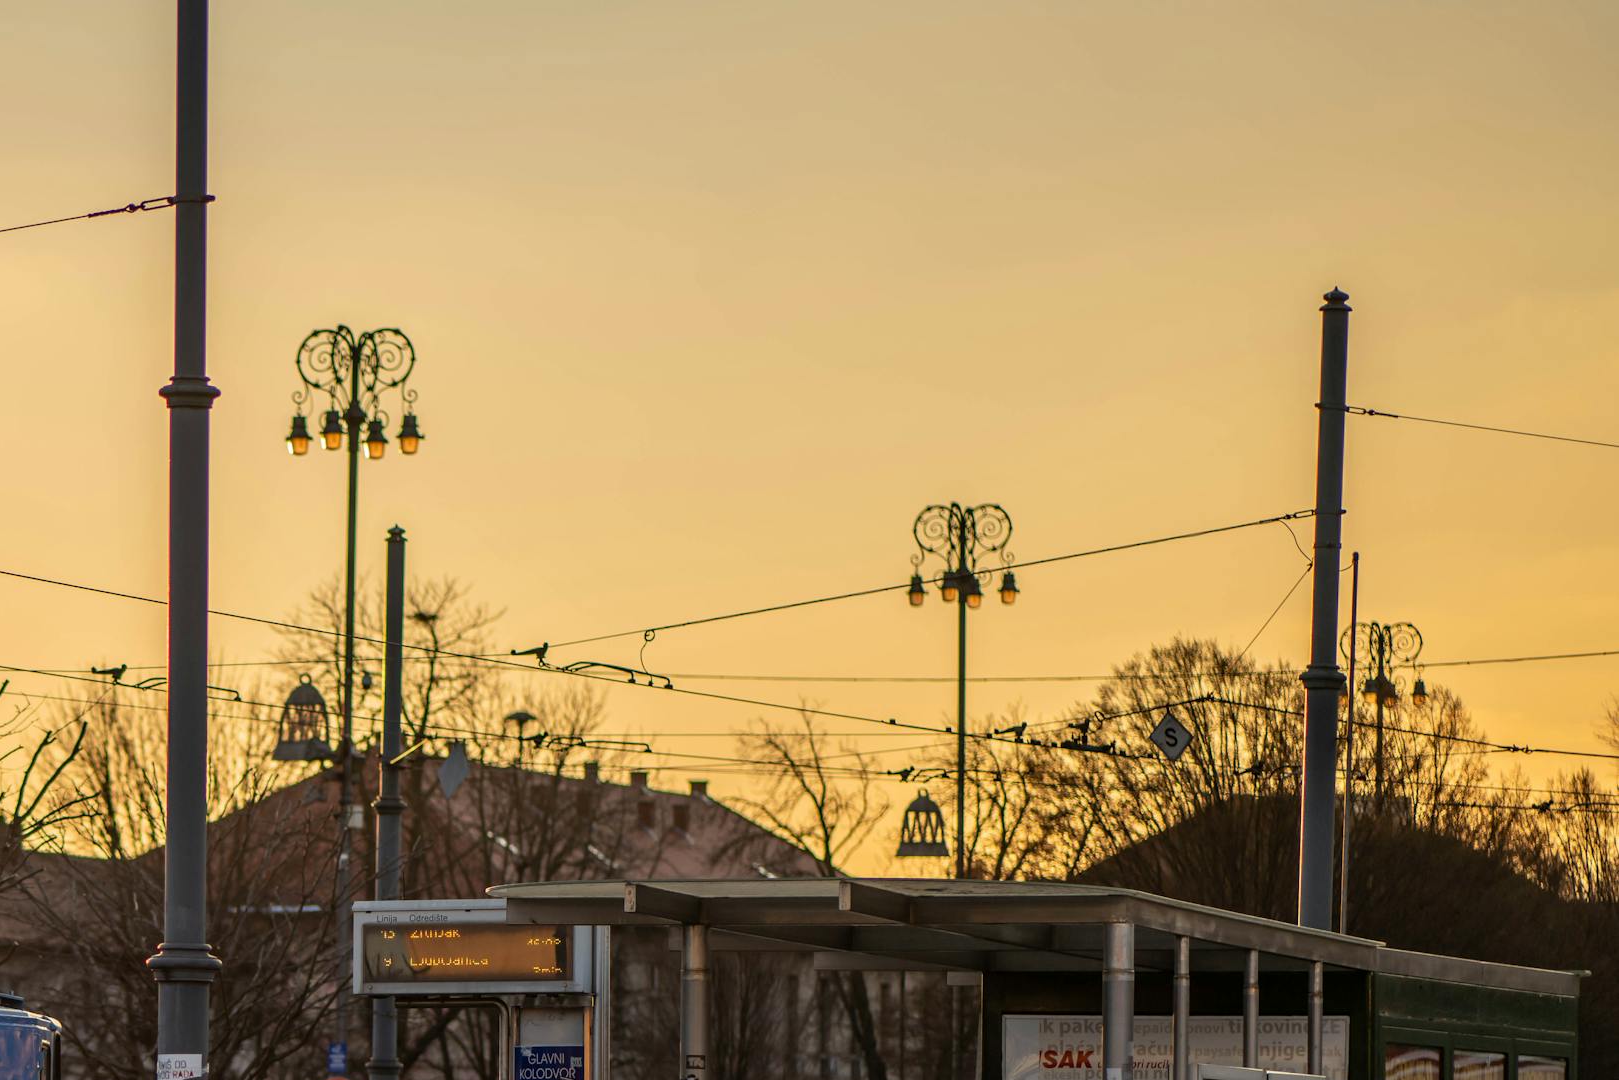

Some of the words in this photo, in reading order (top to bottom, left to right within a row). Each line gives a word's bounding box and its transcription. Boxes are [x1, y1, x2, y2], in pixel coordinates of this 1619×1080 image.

[1165, 728, 1178, 747] S
[377, 914, 397, 924] Linija
[409, 913, 448, 923] Odredište
[527, 1052, 565, 1066] GLAVNI
[519, 1067, 576, 1080] KOLODVOR
